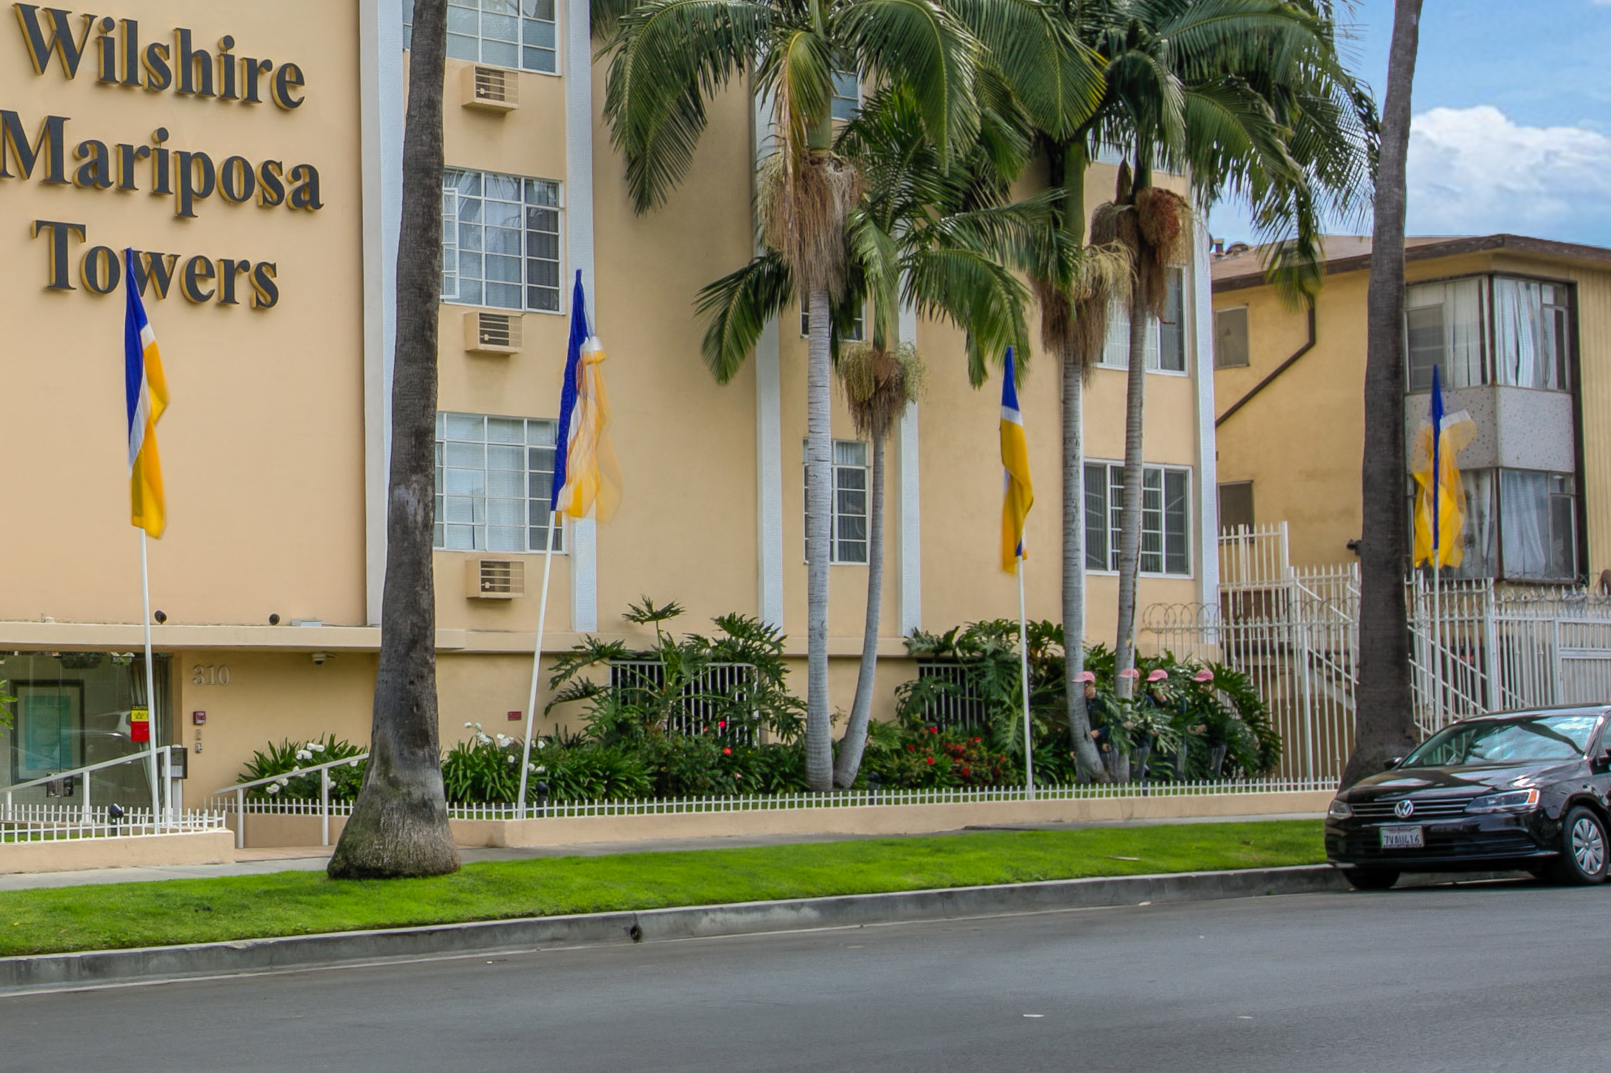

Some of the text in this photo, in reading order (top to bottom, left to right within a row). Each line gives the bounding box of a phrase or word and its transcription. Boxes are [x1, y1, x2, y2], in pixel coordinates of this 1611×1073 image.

[12, 2, 305, 110] Wilshire
[30, 219, 279, 309] Towers
[192, 664, 230, 686] 310
